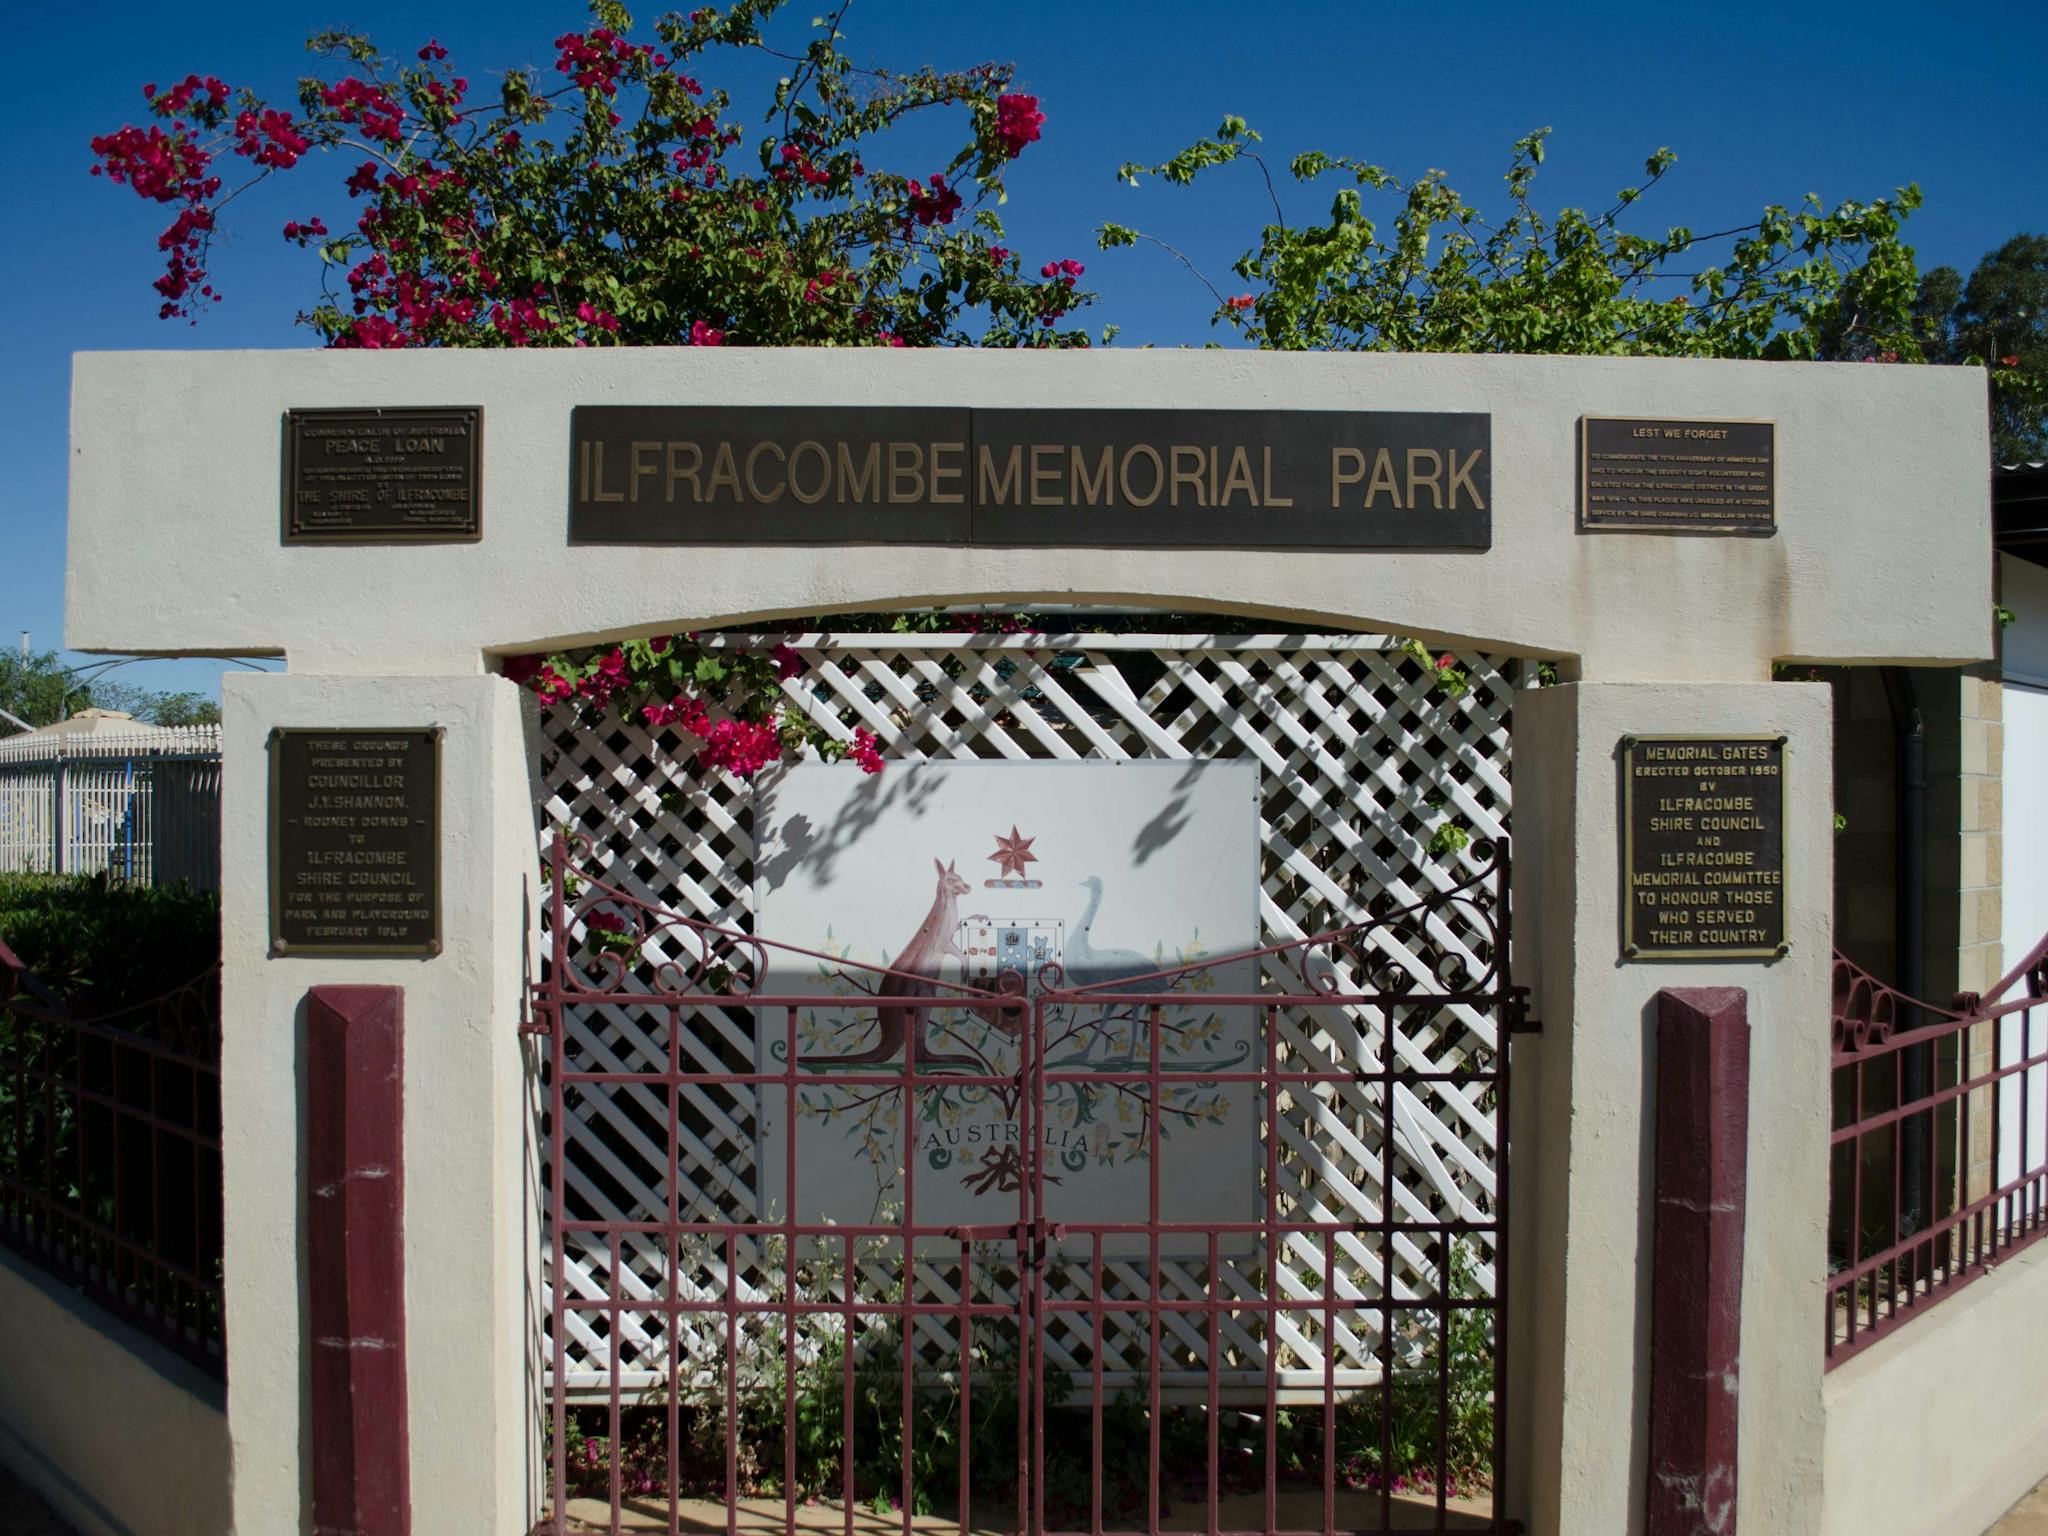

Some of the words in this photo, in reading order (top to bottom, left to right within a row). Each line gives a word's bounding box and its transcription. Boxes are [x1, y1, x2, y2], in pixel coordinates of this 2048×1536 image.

[1632, 428, 1659, 438] LEST
[1664, 428, 1681, 438] WE
[1684, 429, 1728, 440] FORGET
[325, 439, 380, 453] PEACE
[396, 438, 444, 452] LOAN
[1592, 453, 1600, 461] TO
[1648, 454, 1658, 462] THE
[1676, 455, 1714, 463] ANNIVERSARY
[1718, 455, 1725, 463] OF
[579, 440, 965, 504] ILFRACOMBE
[977, 443, 1294, 507] MEMORIAL
[1331, 446, 1485, 510] PARK
[1696, 483, 1724, 491] DISTRICT
[298, 490, 320, 502] THE
[330, 490, 369, 502] SHIRE
[377, 489, 392, 502] OF
[398, 488, 468, 501] ILFRACOMBE
[308, 741, 347, 751] THESE
[353, 741, 409, 751] GROUNDS
[1646, 748, 1718, 760] MEMORIAL
[1722, 746, 1768, 760] GATES
[312, 758, 384, 768] PRESENTED
[388, 758, 403, 768] BY
[1636, 766, 1689, 776] ERECTED
[1694, 766, 1746, 776] OCTOBER
[1750, 765, 1778, 776] 1950
[308, 776, 404, 788] COUNCILLOR
[1700, 782, 1716, 792] BY
[1660, 797, 1753, 812] ILFRACOMBE
[304, 816, 356, 827] RODNEY
[361, 816, 408, 827] DOWNS
[1650, 818, 1694, 831] SHIRE
[1700, 816, 1764, 830] COUNCIL
[349, 834, 366, 844] TO
[1696, 836, 1720, 846] AND
[307, 852, 407, 865] ILFRACOMBE
[1660, 852, 1754, 866] ILFRACOMBE
[296, 872, 342, 886] SHIRE
[349, 872, 416, 886] COUNCIL
[1632, 872, 1700, 886] MEMORIAL
[1704, 872, 1780, 886] COMMITTEE
[288, 892, 312, 902] FOR
[319, 892, 342, 902] THE
[348, 892, 402, 902] PURPOSE
[408, 892, 424, 902] OF
[1638, 892, 1656, 906] TO
[1660, 892, 1719, 905] HONOUR
[1726, 891, 1773, 904] THOSE
[286, 910, 318, 920] PARK
[323, 910, 346, 920] AND
[352, 910, 430, 920] PLAYGROUND
[1658, 911, 1689, 924] WHO
[1696, 910, 1754, 924] SERVED
[307, 927, 368, 937] FEBRUARY
[1650, 931, 1693, 944] THEIR
[1698, 930, 1767, 944] COUNTRY
